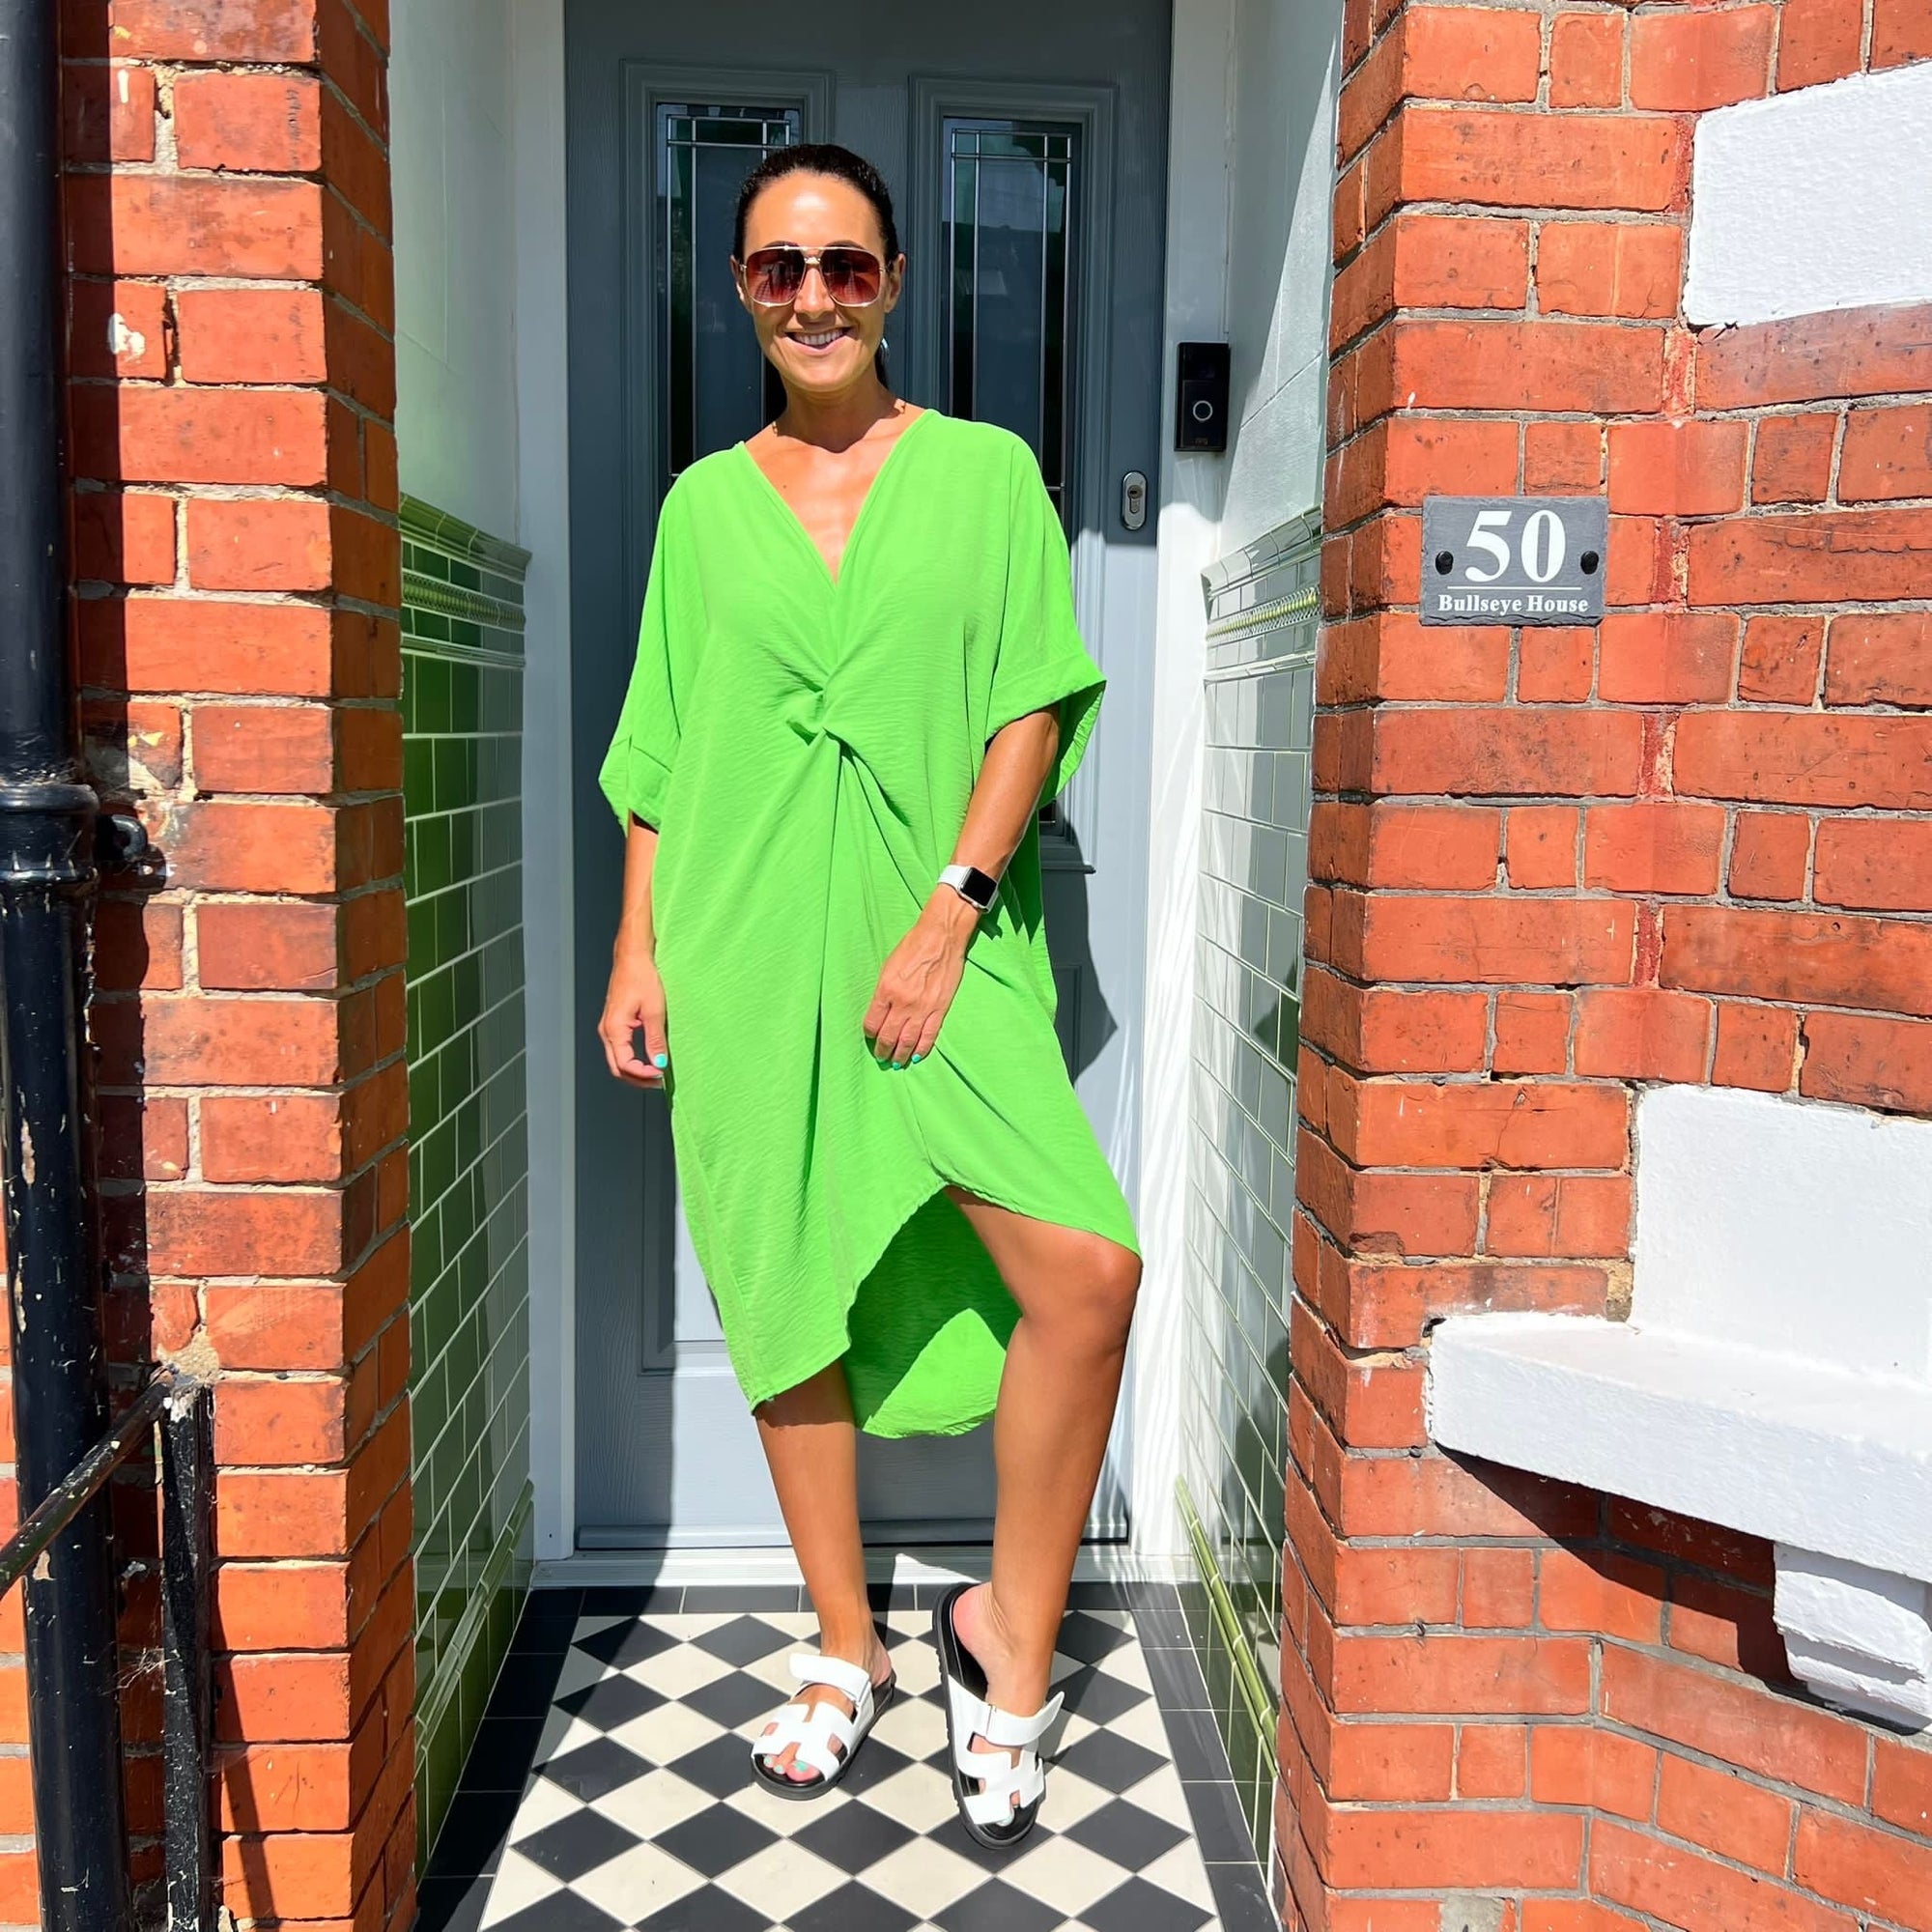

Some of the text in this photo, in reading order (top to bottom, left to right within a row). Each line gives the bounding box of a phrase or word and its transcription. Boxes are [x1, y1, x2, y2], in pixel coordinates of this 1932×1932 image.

[1465, 510, 1566, 582] 50
[1438, 595, 1589, 615] Bullseye House
